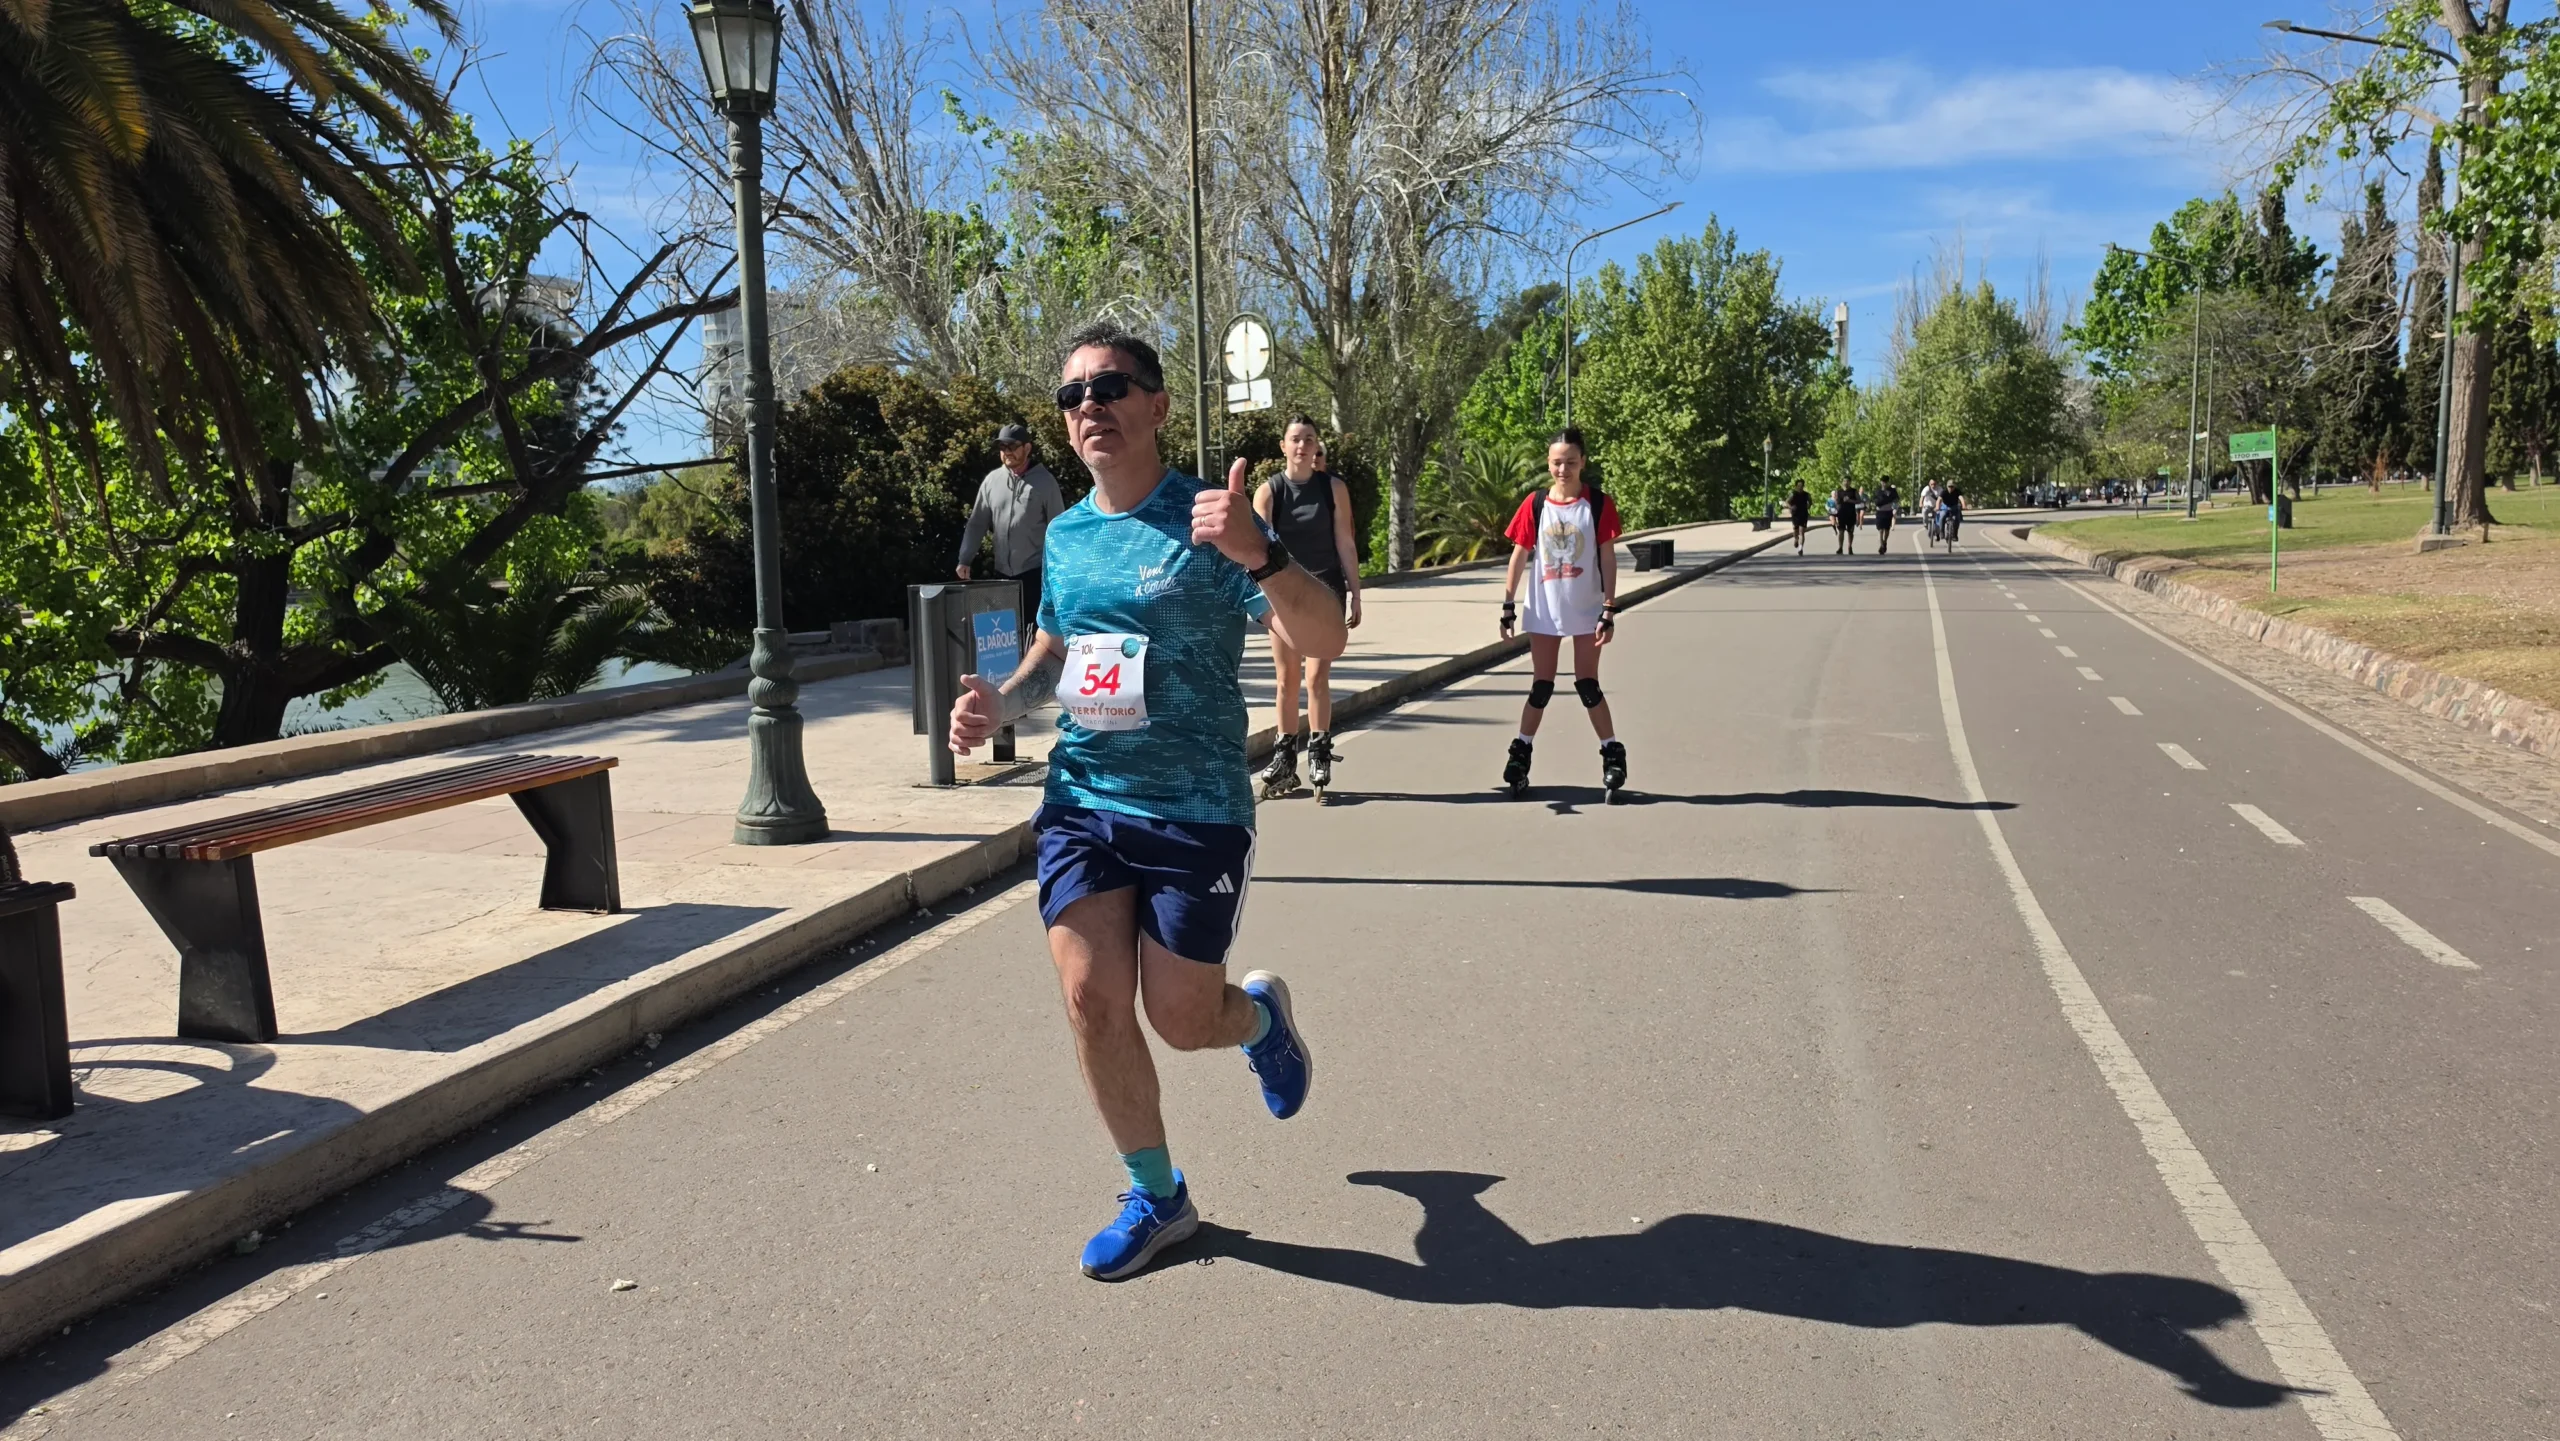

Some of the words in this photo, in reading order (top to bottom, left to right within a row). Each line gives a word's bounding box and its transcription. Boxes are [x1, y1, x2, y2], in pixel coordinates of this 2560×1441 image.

[977, 636, 987, 653] EL
[987, 630, 1018, 651] PARQUE
[1079, 663, 1122, 696] 54
